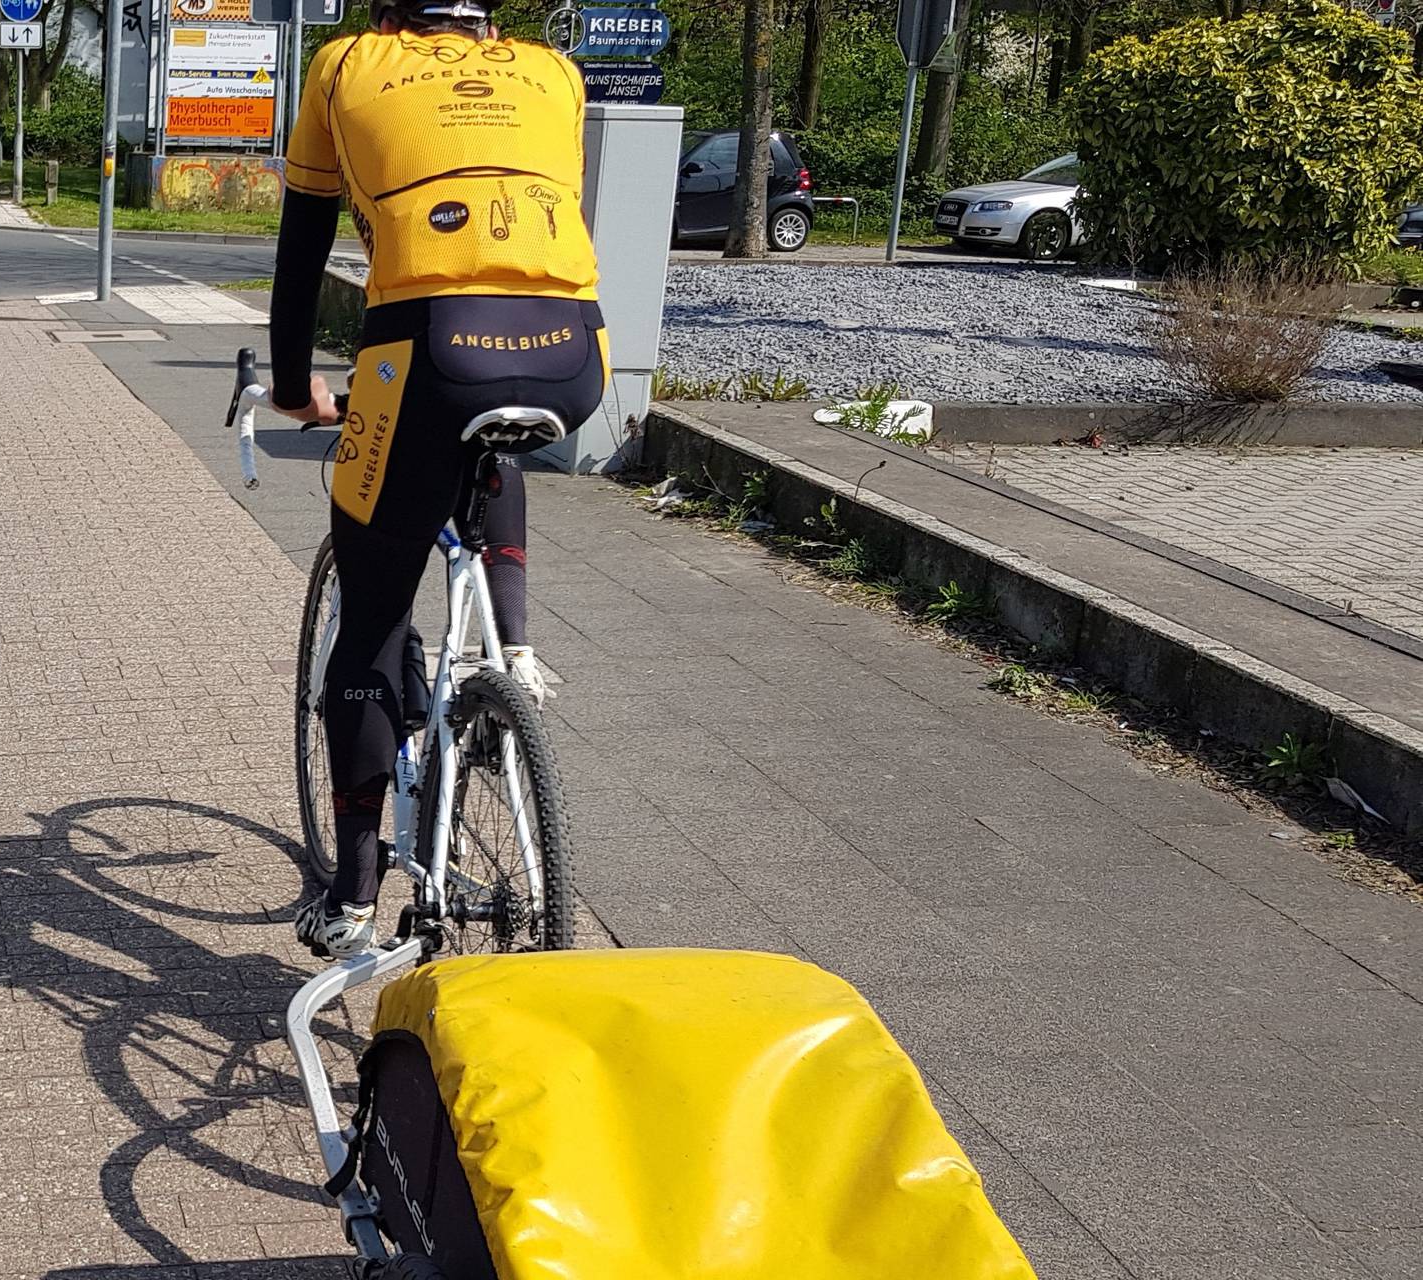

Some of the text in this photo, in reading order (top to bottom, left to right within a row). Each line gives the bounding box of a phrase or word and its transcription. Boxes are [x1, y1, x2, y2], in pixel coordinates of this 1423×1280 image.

[590, 18, 663, 33] KREBER
[588, 35, 662, 46] Baumaschinen
[170, 70, 211, 78] Auto-Service
[381, 69, 547, 94] ANGELBIKES
[584, 75, 663, 86] KUNSTSCHMIEDE
[206, 86, 223, 94] Auto
[225, 86, 272, 95] Waschanlage
[605, 85, 646, 96] JANSEN
[169, 101, 254, 116] Physiotherapie
[438, 102, 517, 113] SIEGER
[169, 114, 231, 126] Meerbusch
[450, 327, 573, 350] ANGELBIKES
[357, 412, 390, 501] ANGELBIKES
[344, 688, 384, 700] GORE
[376, 1116, 435, 1256] BURLEY
